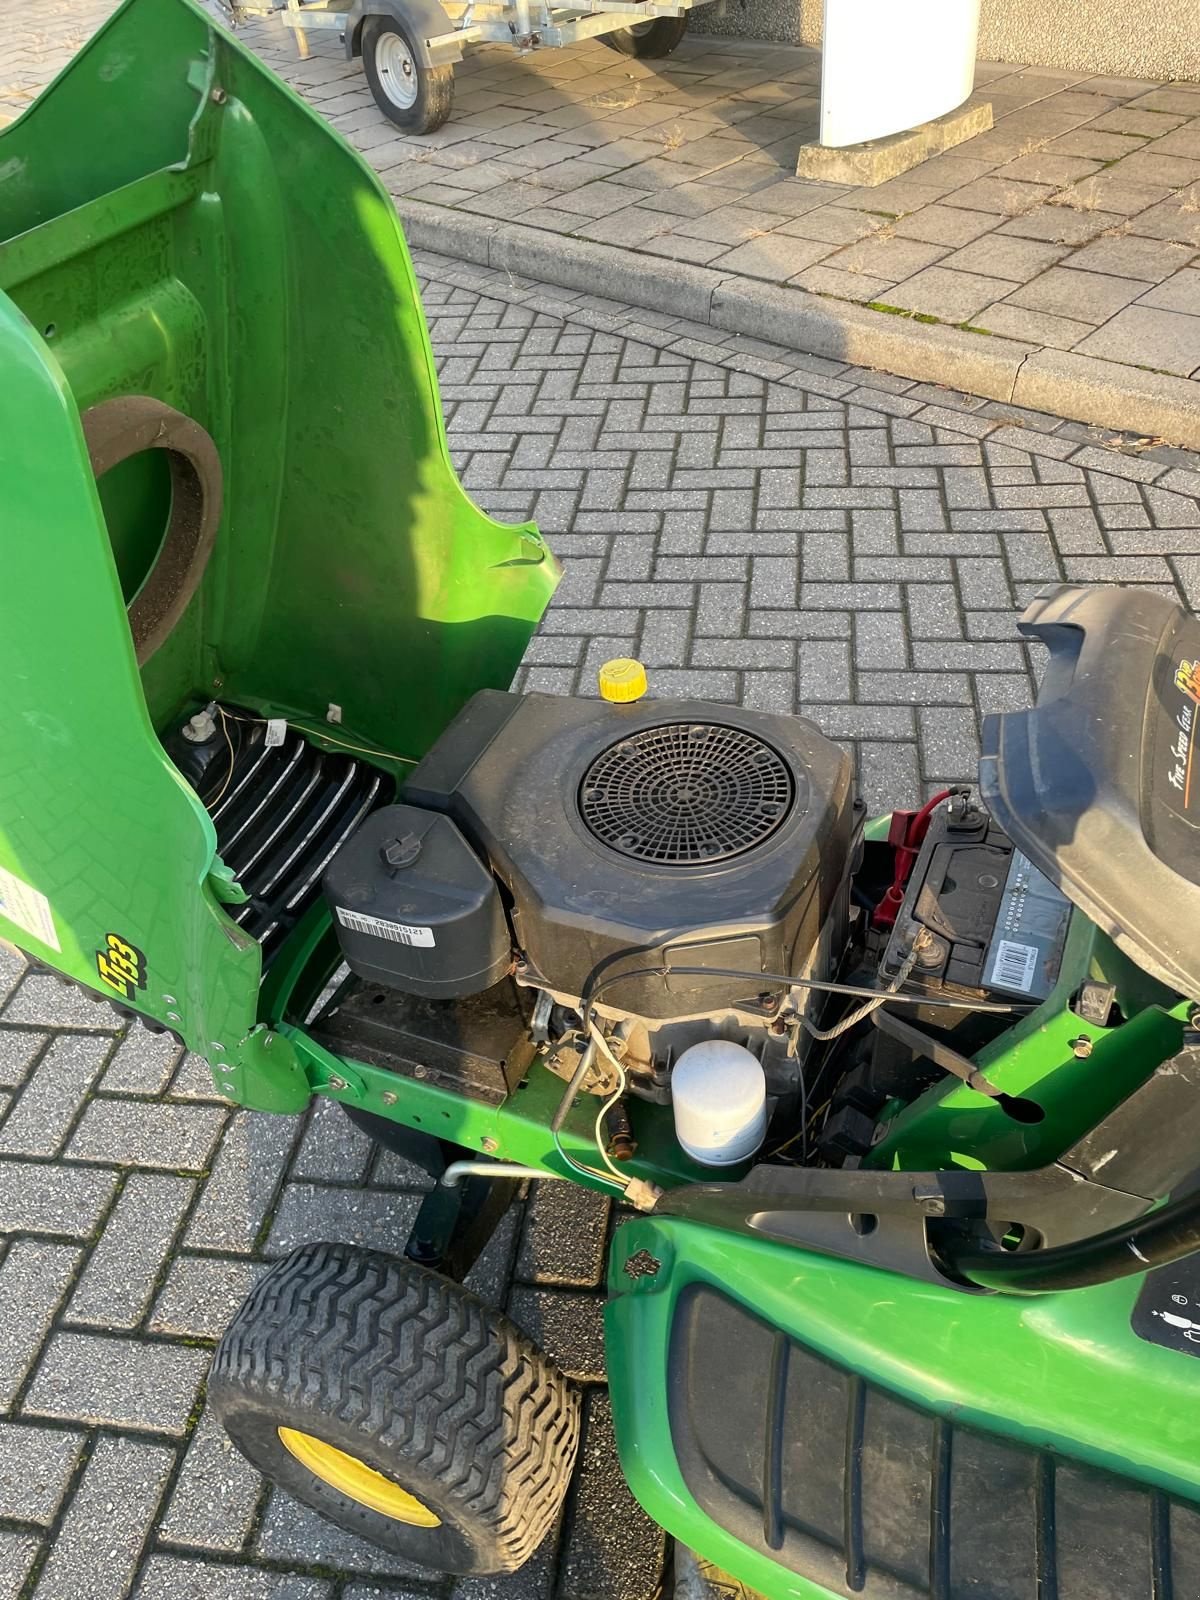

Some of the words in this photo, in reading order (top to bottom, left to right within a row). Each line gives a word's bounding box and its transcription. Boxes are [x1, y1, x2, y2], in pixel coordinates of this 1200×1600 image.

[1176, 705, 1193, 732] GEAR
[1170, 731, 1188, 766] SPEED
[1168, 763, 1185, 791] FIVE
[97, 934, 142, 999] LT133
